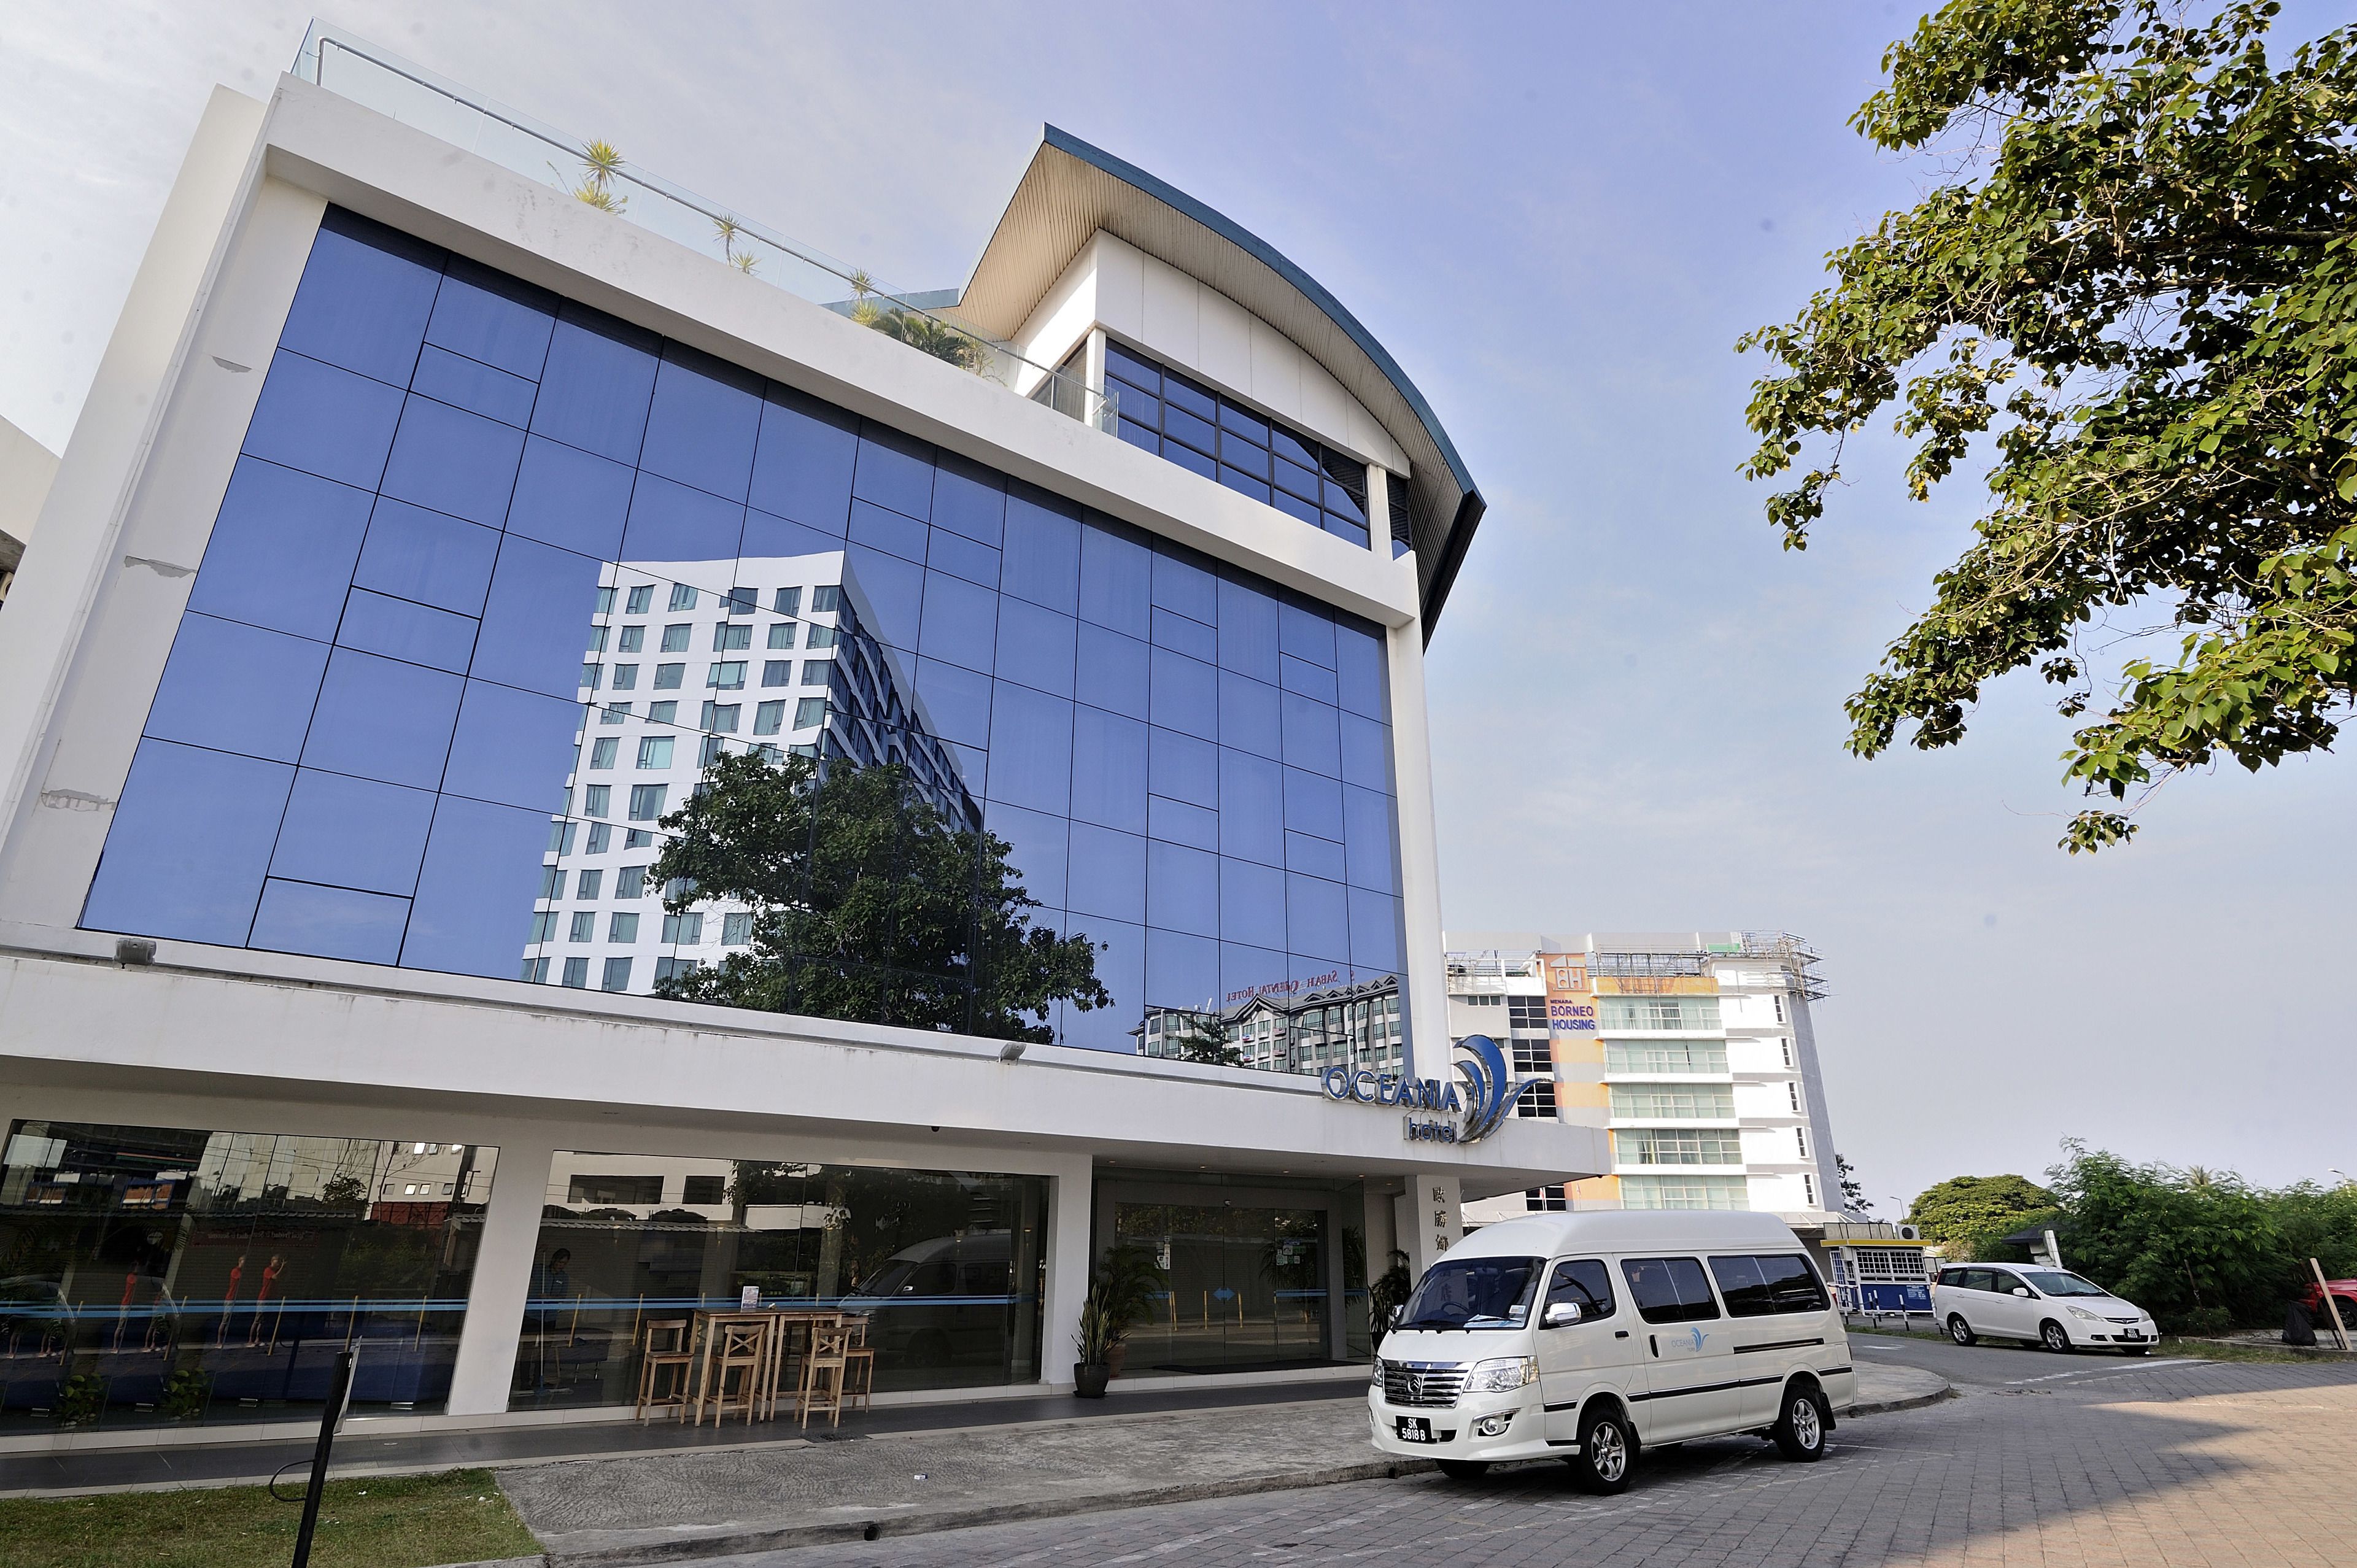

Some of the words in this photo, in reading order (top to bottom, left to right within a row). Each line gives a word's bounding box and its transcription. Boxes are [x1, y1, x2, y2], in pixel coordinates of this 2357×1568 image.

[1550, 1006, 1593, 1017] BORNEO
[1552, 1019, 1595, 1030] HOUSING
[1321, 1066, 1462, 1113] OCEANIA
[1404, 1116, 1457, 1143] hotel
[1407, 1418, 1418, 1429] SK
[1402, 1427, 1419, 1440] 5818
[1420, 1429, 1426, 1441] B
